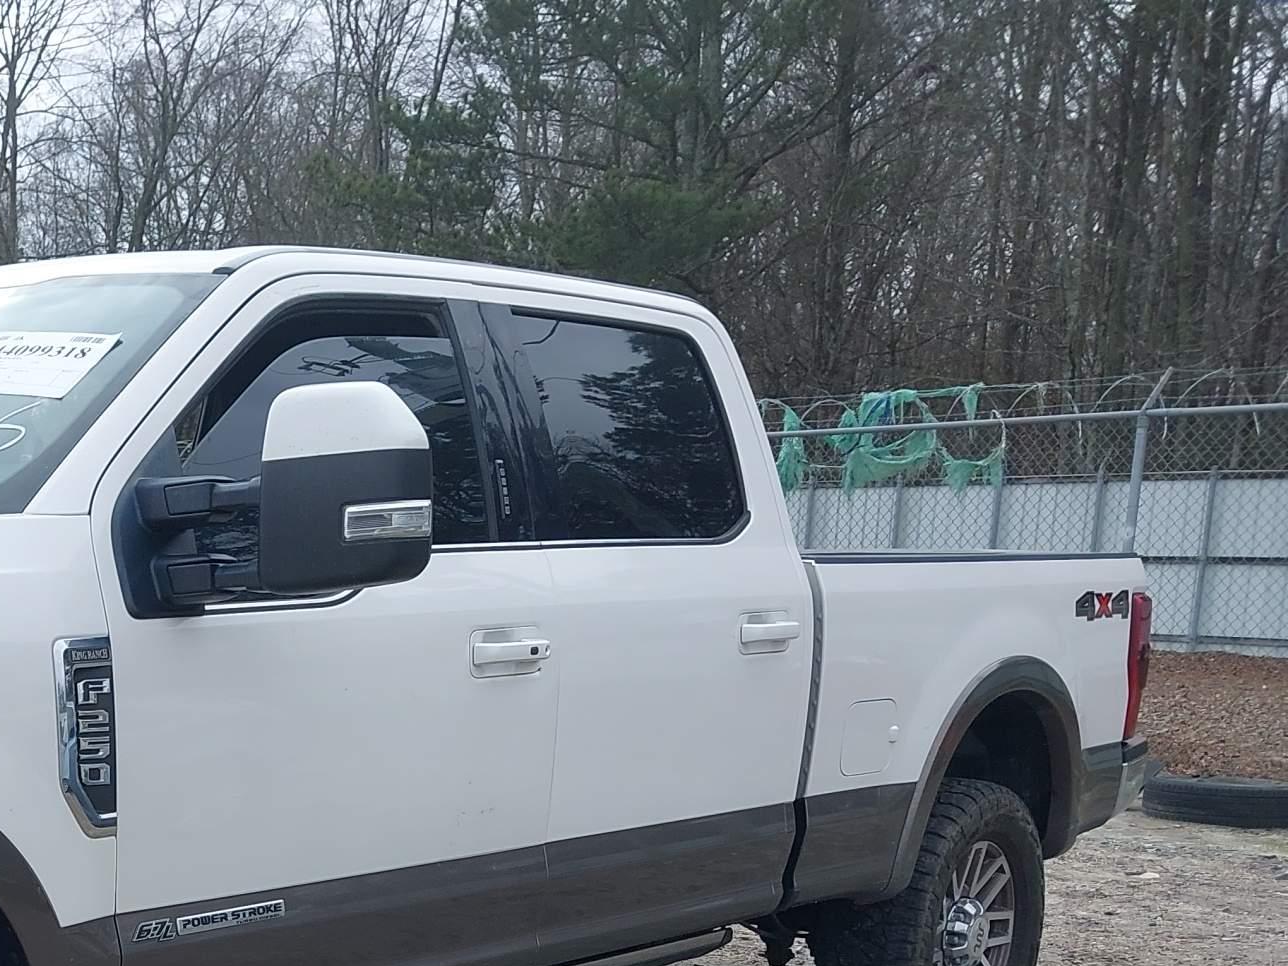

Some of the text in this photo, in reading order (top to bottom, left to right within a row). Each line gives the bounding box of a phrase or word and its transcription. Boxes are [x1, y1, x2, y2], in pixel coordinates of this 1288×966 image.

[77, 678, 111, 785] F250
[182, 913, 228, 929] POWER
[231, 902, 283, 921] STROKE
